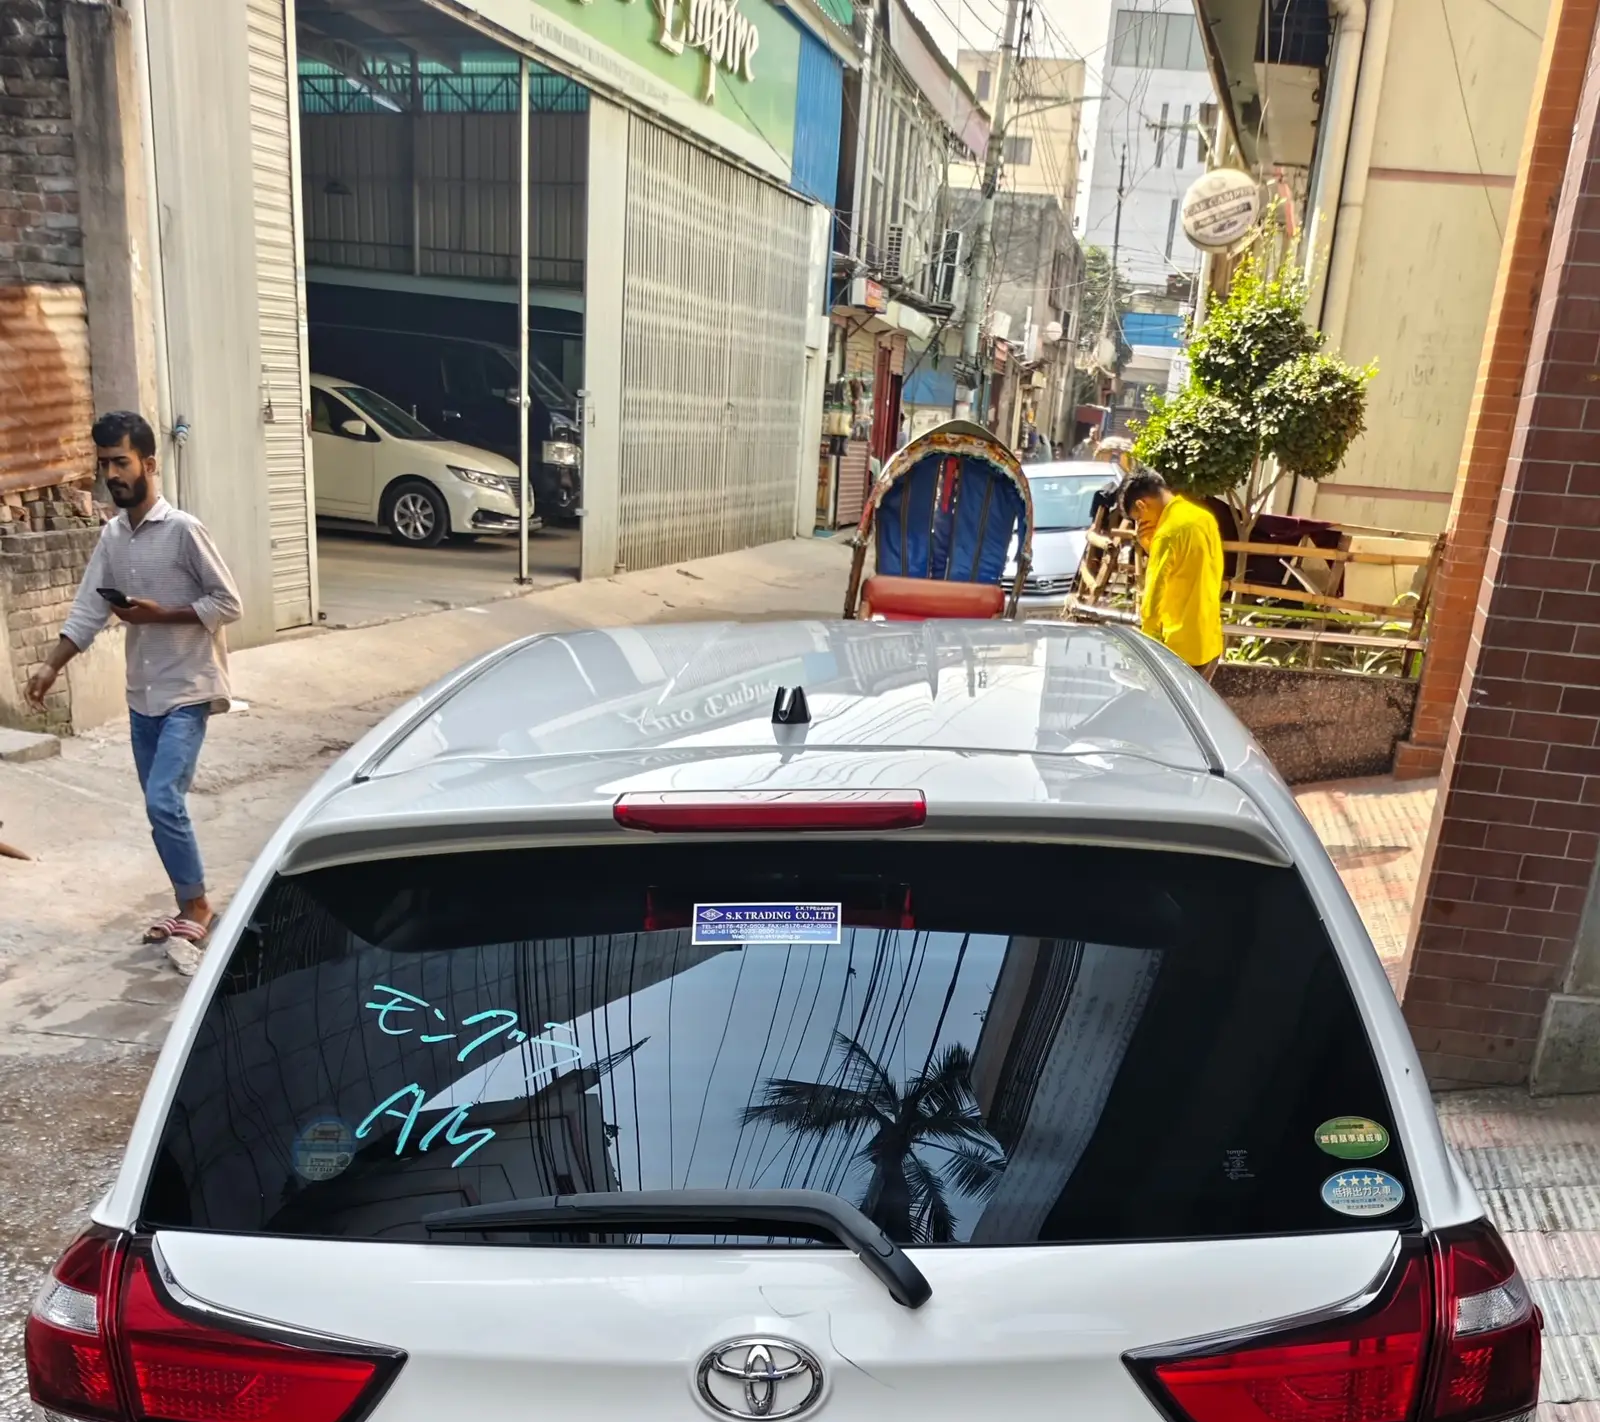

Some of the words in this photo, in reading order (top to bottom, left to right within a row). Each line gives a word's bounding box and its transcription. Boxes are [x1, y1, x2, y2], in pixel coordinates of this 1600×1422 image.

[653, 0, 759, 104] Empire
[725, 911, 743, 920] S.K
[744, 911, 791, 920] TRADING
[795, 911, 836, 921] CO.,LTD
[1332, 1185, 1391, 1198] 低排出ガス車
